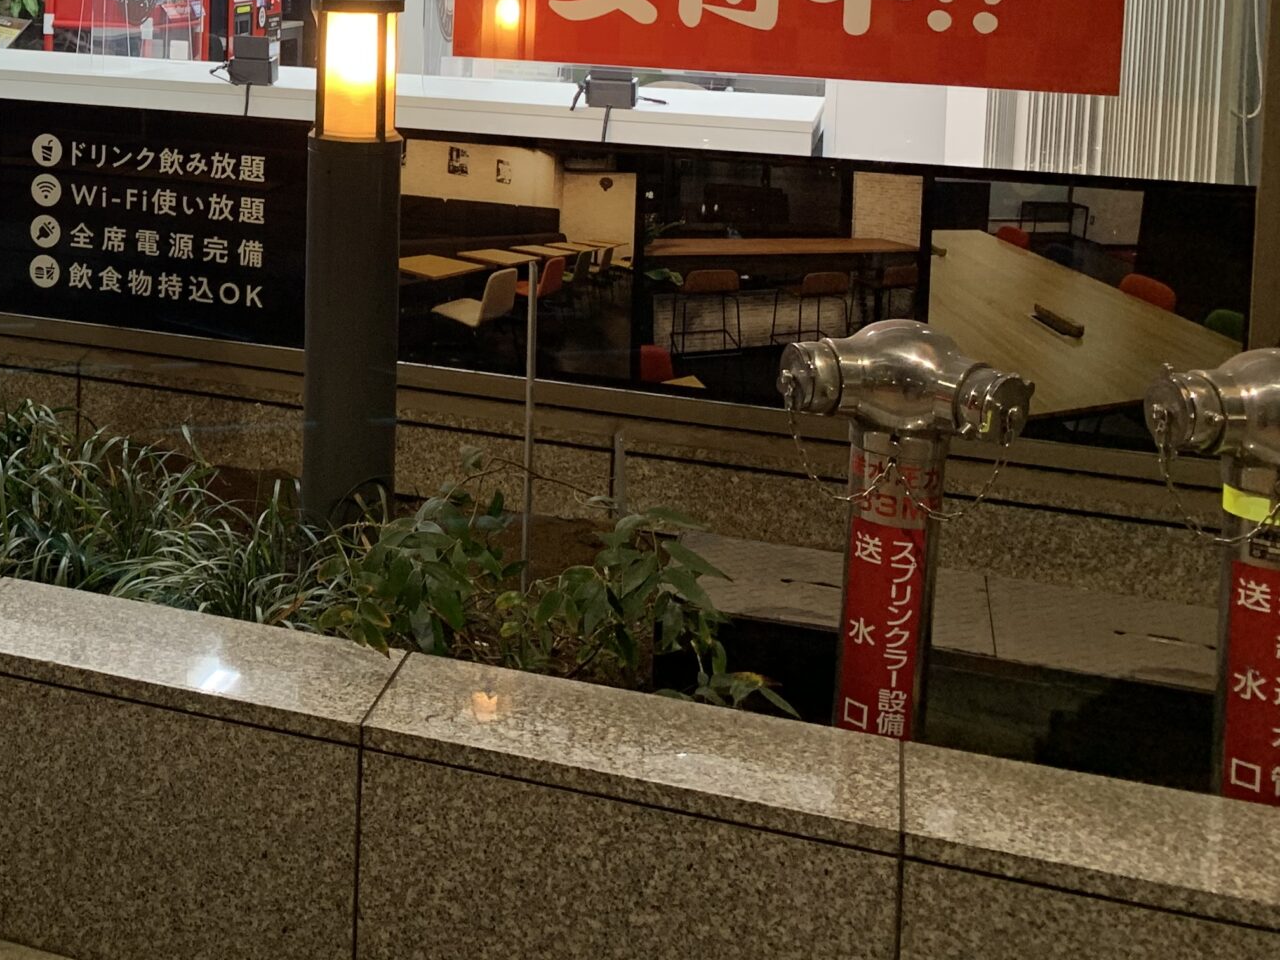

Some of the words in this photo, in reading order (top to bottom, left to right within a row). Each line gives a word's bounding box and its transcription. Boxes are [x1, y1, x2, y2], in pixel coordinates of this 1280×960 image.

[70, 141, 266, 183] ドリンク飲み放題
[70, 183, 266, 225] Wi-Fi使い放題
[69, 223, 264, 269] 全席電源完備
[68, 262, 264, 309] 飲食物持込OK
[876, 540, 918, 737] スプリンクラー設備
